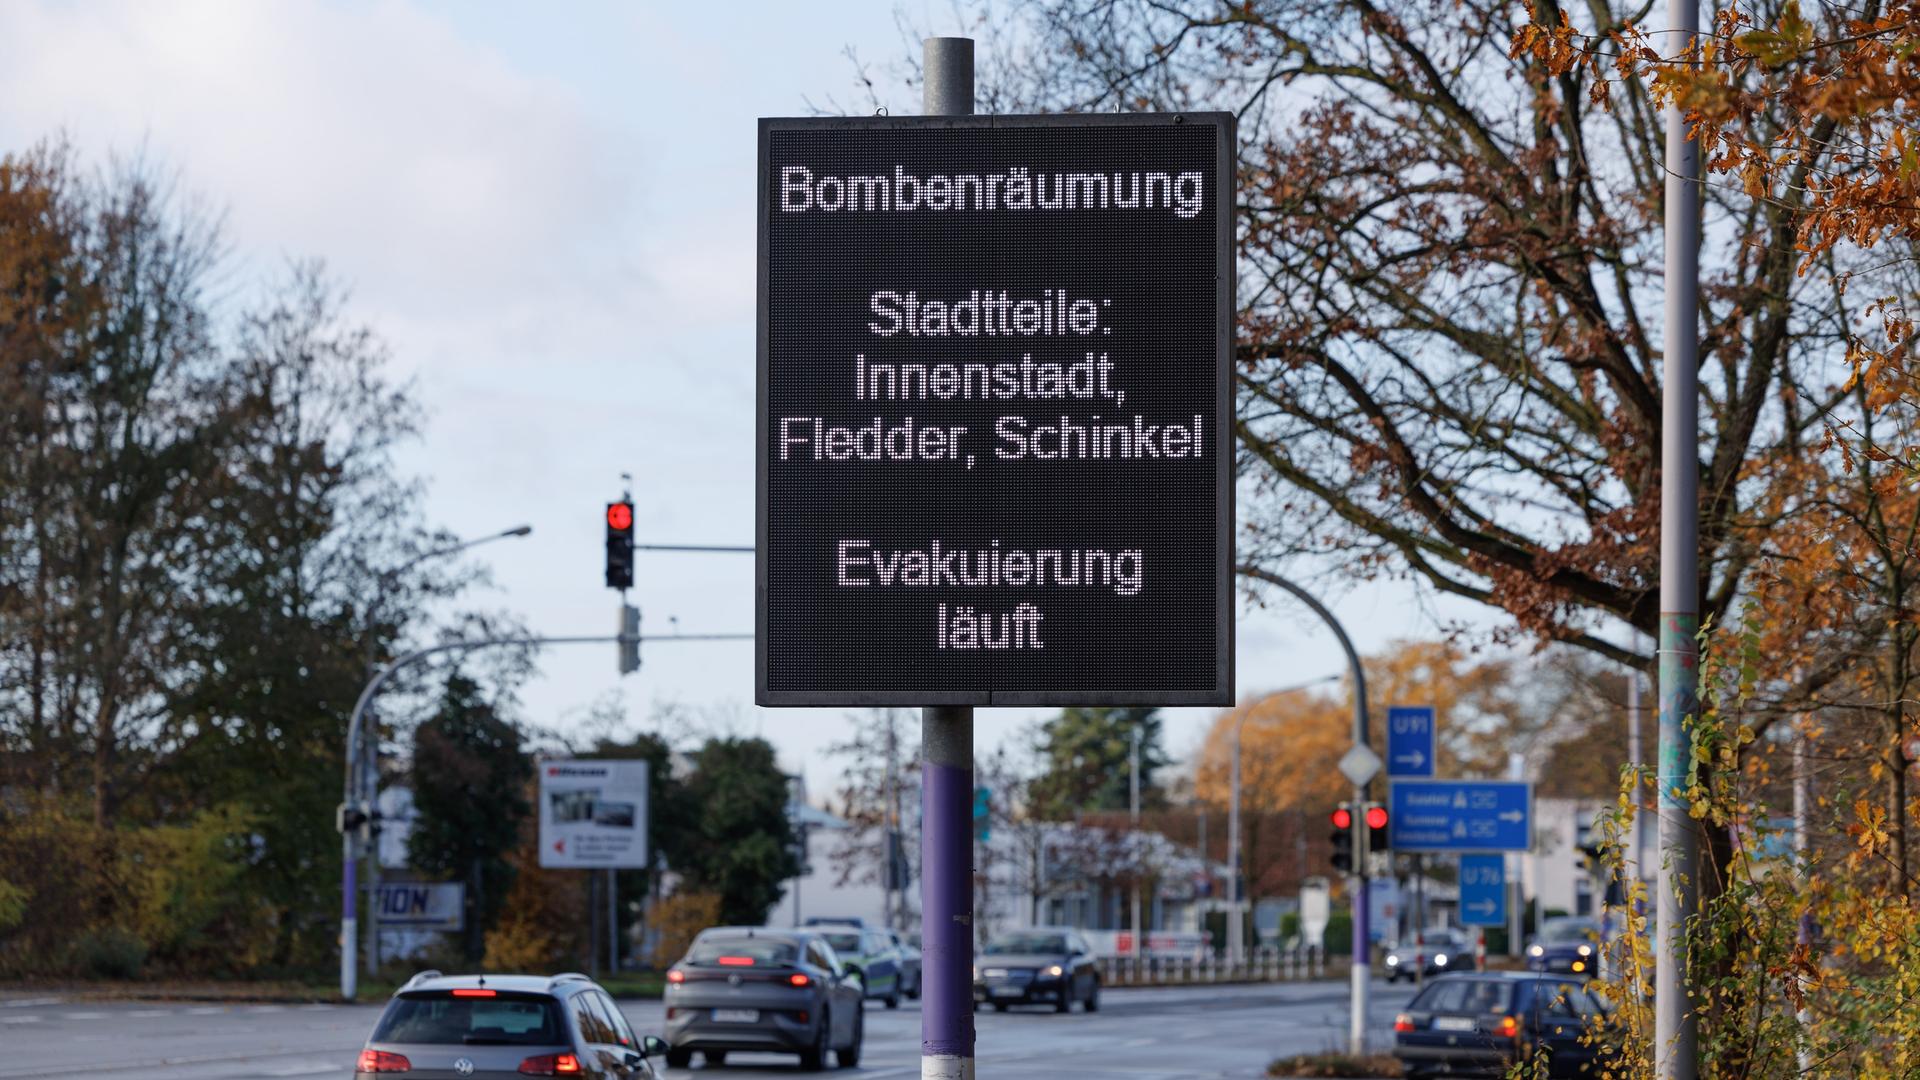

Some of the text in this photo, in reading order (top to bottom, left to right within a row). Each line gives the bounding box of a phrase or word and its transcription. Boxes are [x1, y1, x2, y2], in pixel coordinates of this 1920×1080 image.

[781, 165, 1204, 218] Bombenräumung
[868, 289, 1112, 337] Stadtteile:
[856, 352, 1126, 407] Innenstadt,
[780, 414, 1204, 470] Fledder, Schinkel
[837, 539, 1143, 596] Evakuierung
[937, 602, 1045, 649] läuft
